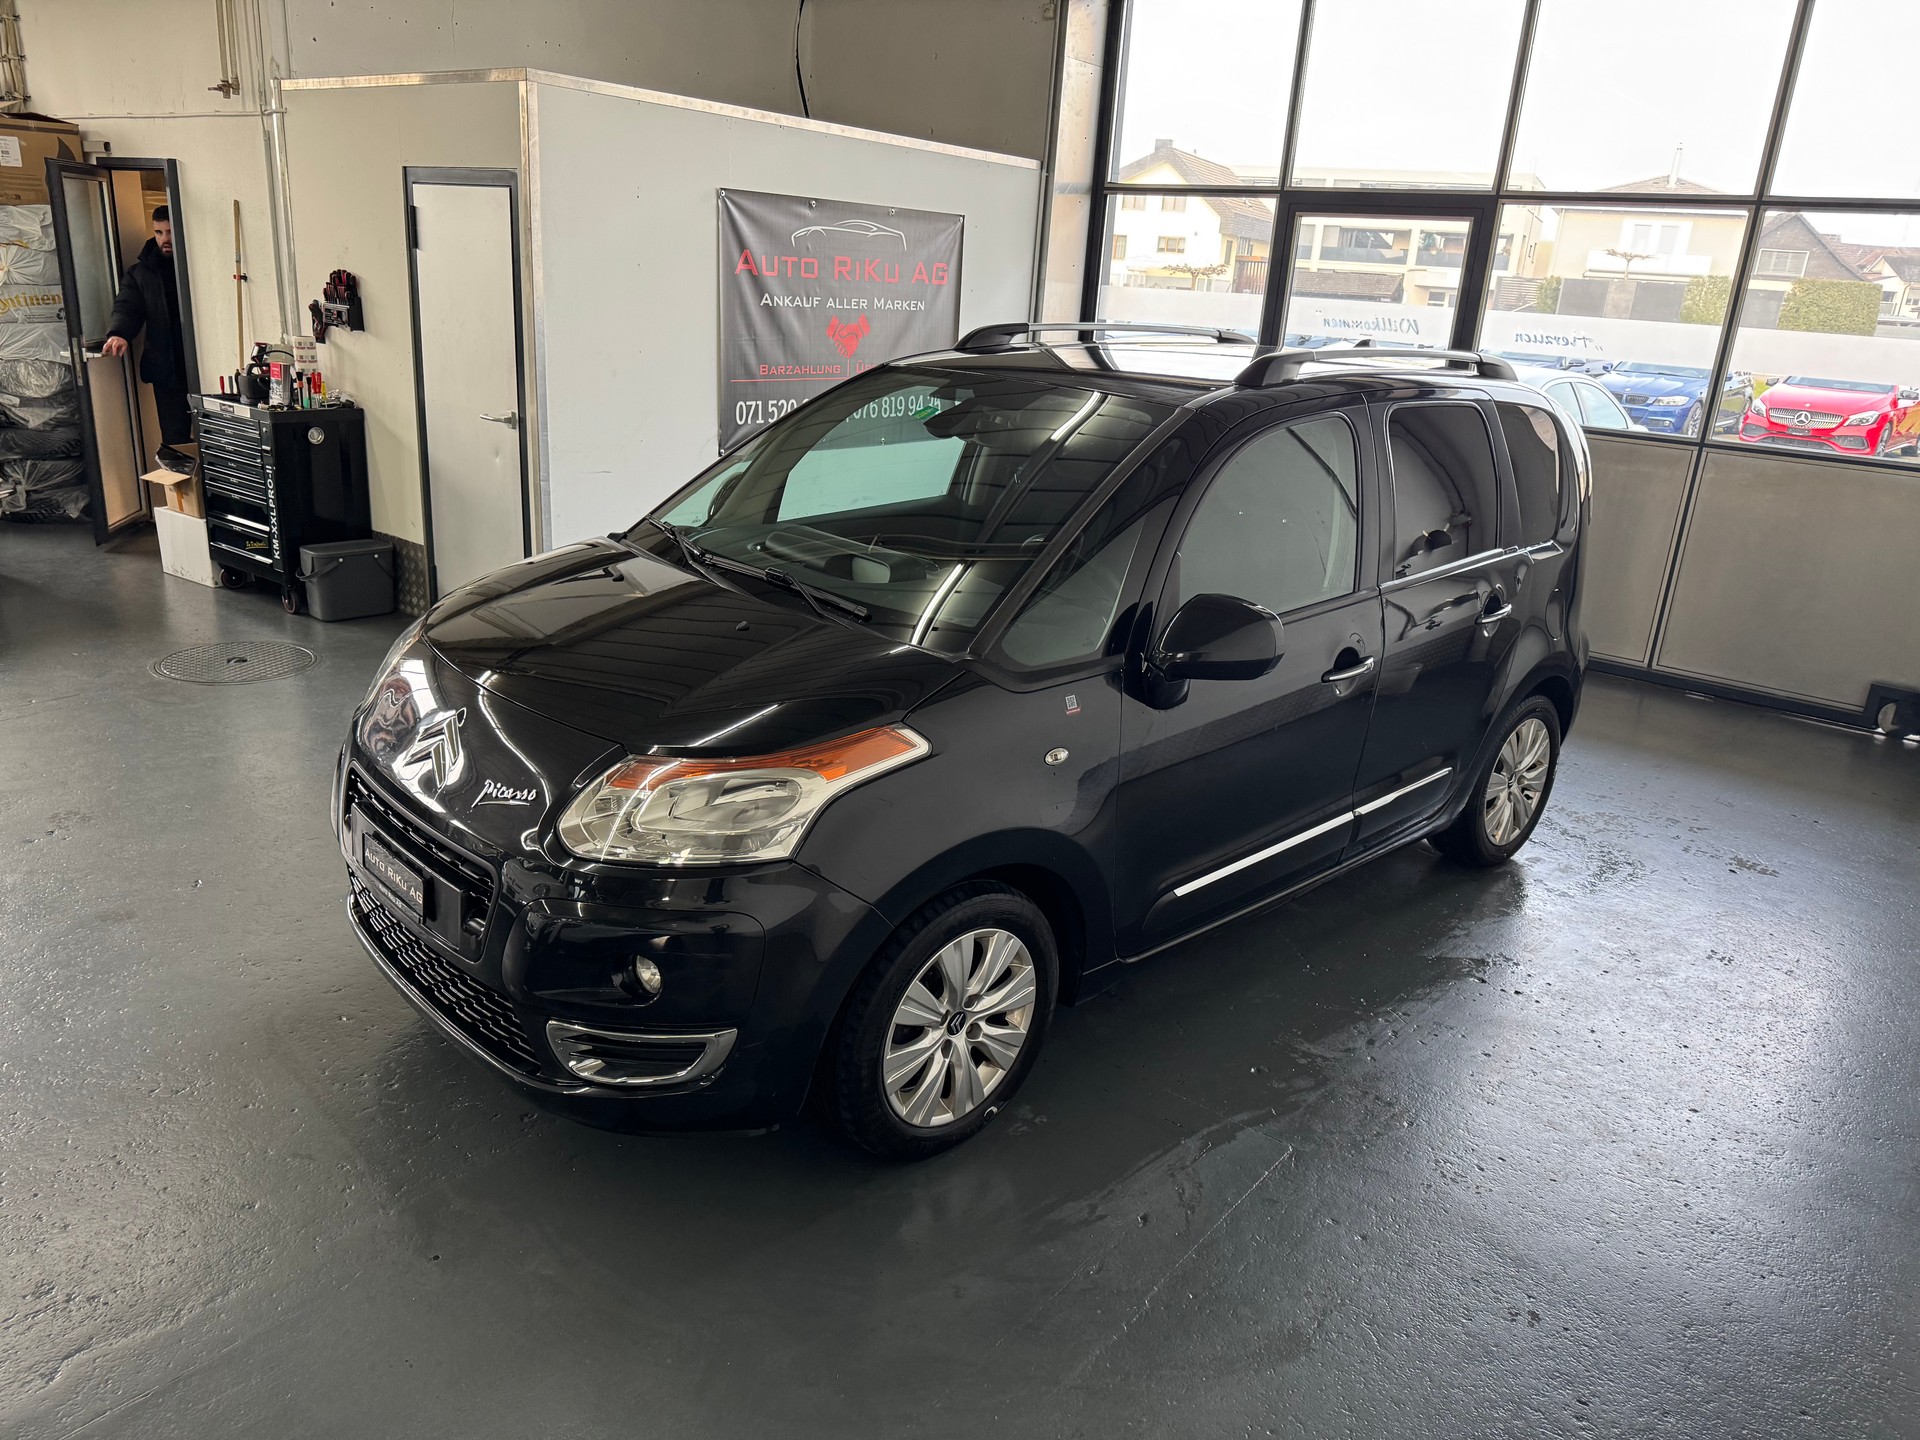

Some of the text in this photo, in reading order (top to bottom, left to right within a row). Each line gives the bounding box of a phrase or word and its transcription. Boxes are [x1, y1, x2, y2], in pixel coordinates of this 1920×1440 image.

[911, 261, 948, 286] AG
[0, 292, 63, 314] ontinen
[826, 297, 868, 310] ALLER
[735, 400, 765, 425] 071
[881, 396, 905, 418] 819
[908, 395, 924, 417] 94
[409, 886, 423, 905] AG
